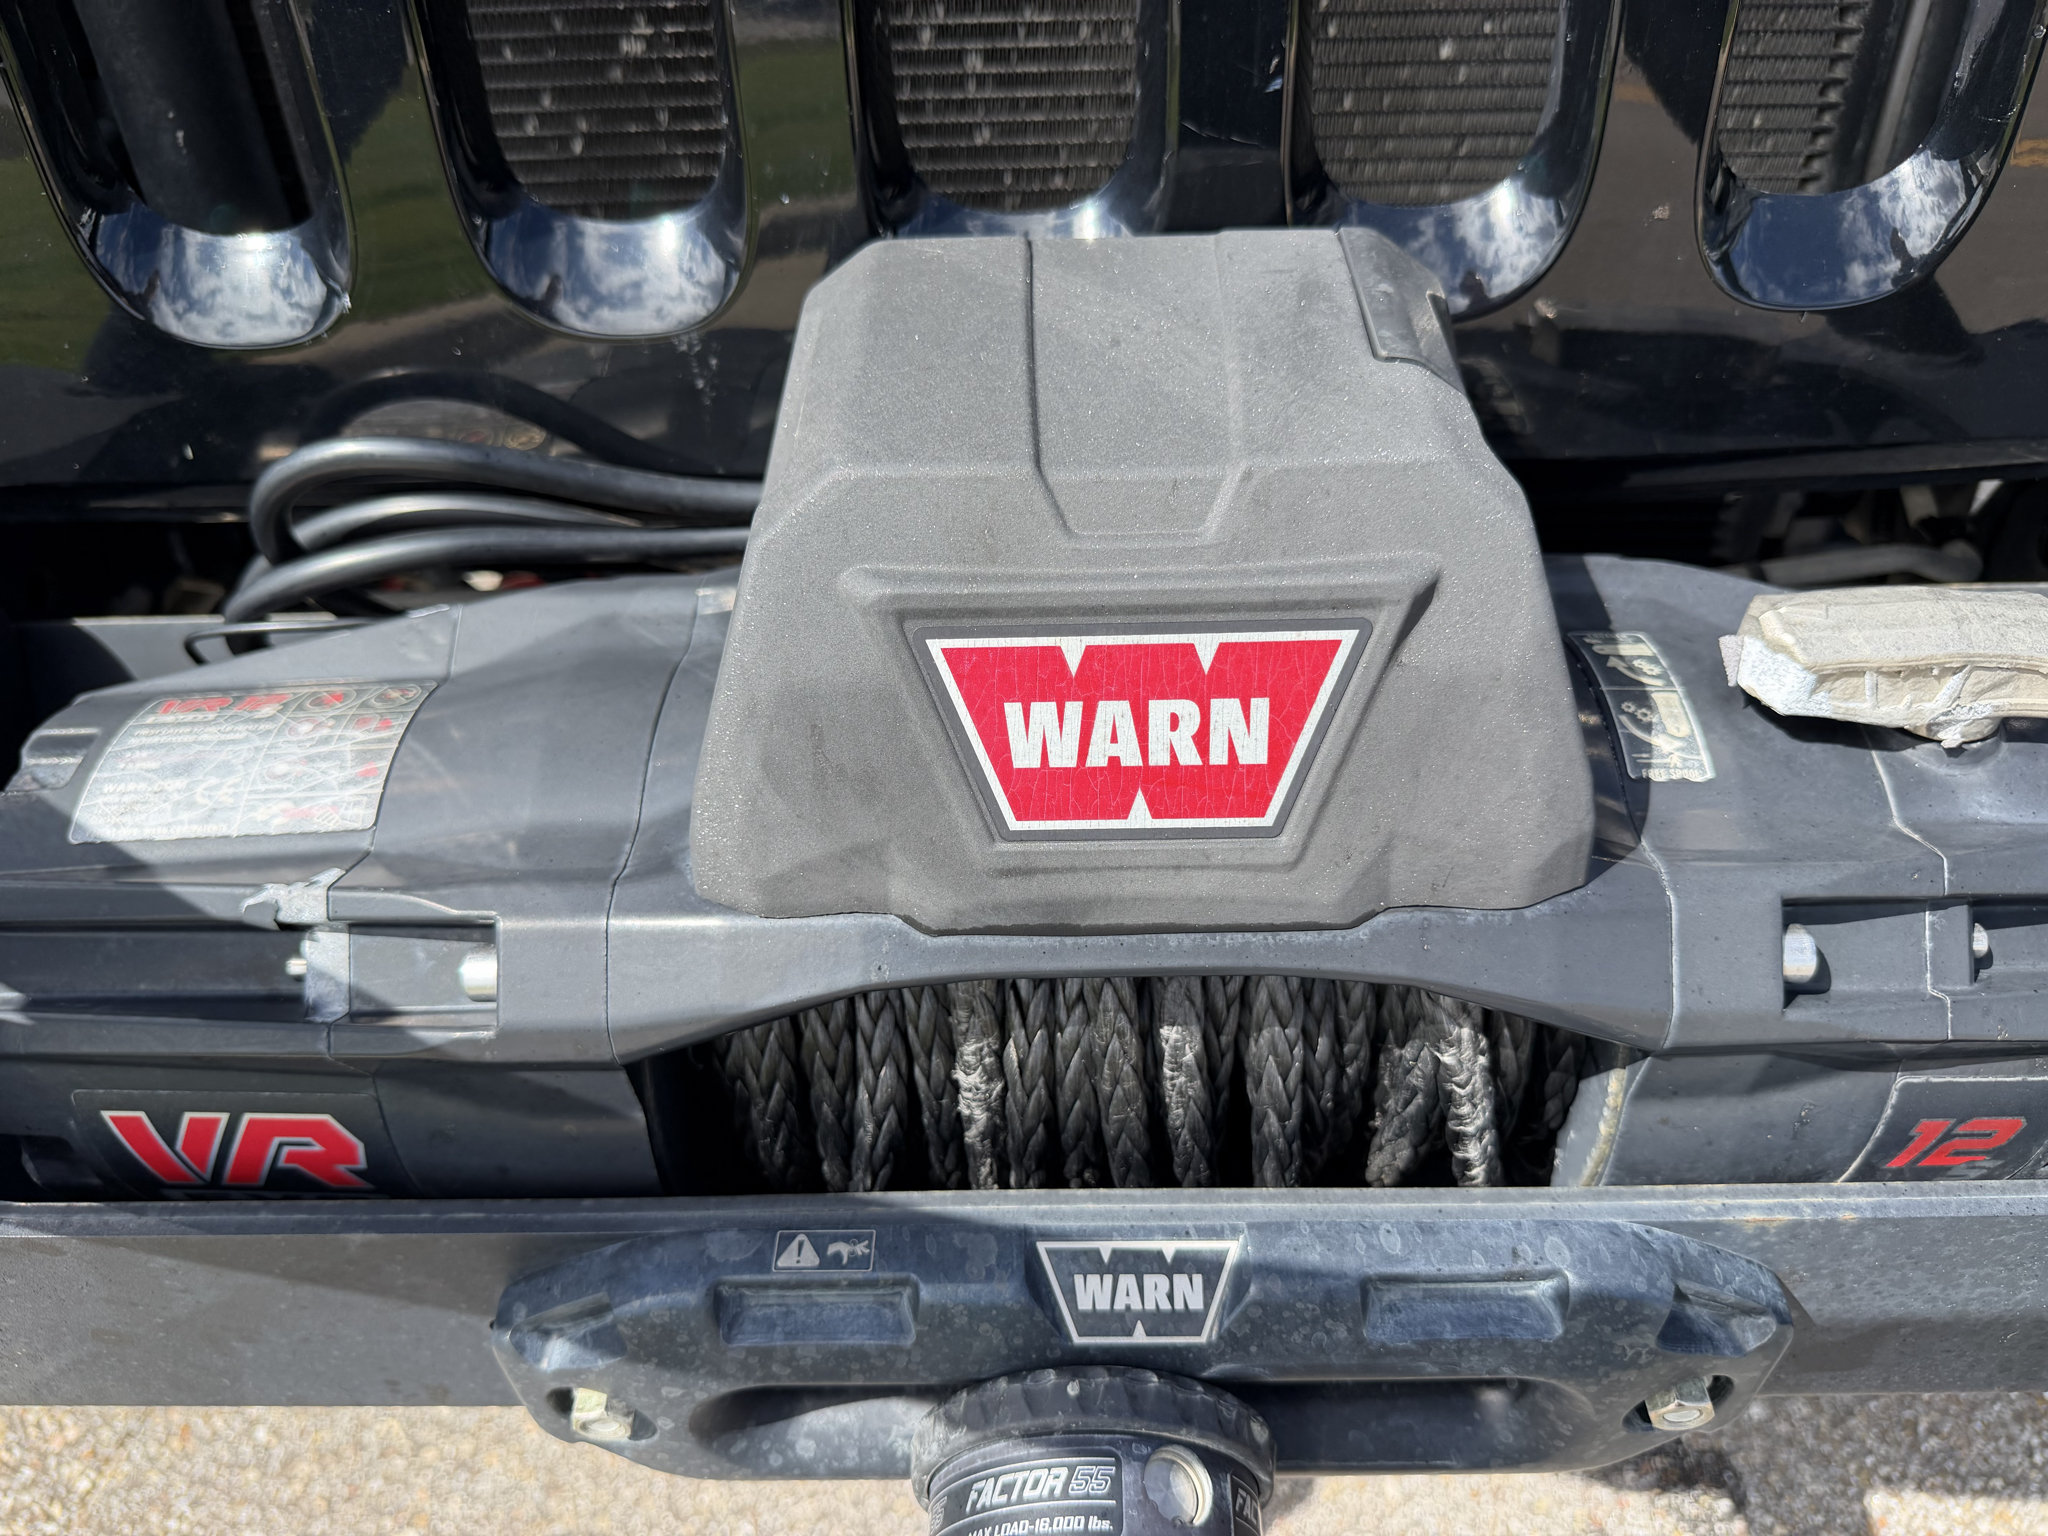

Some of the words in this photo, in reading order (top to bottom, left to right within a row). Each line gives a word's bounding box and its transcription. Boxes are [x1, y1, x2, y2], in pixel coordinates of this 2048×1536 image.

[1003, 697, 1270, 769] WARN
[100, 1110, 374, 1190] VR
[1882, 1116, 2028, 1168] 12
[1073, 1273, 1205, 1311] WARN
[965, 1466, 1068, 1515] FACTOR
[1068, 1465, 1116, 1496] 55
[1087, 1515, 1113, 1532] lbs.
